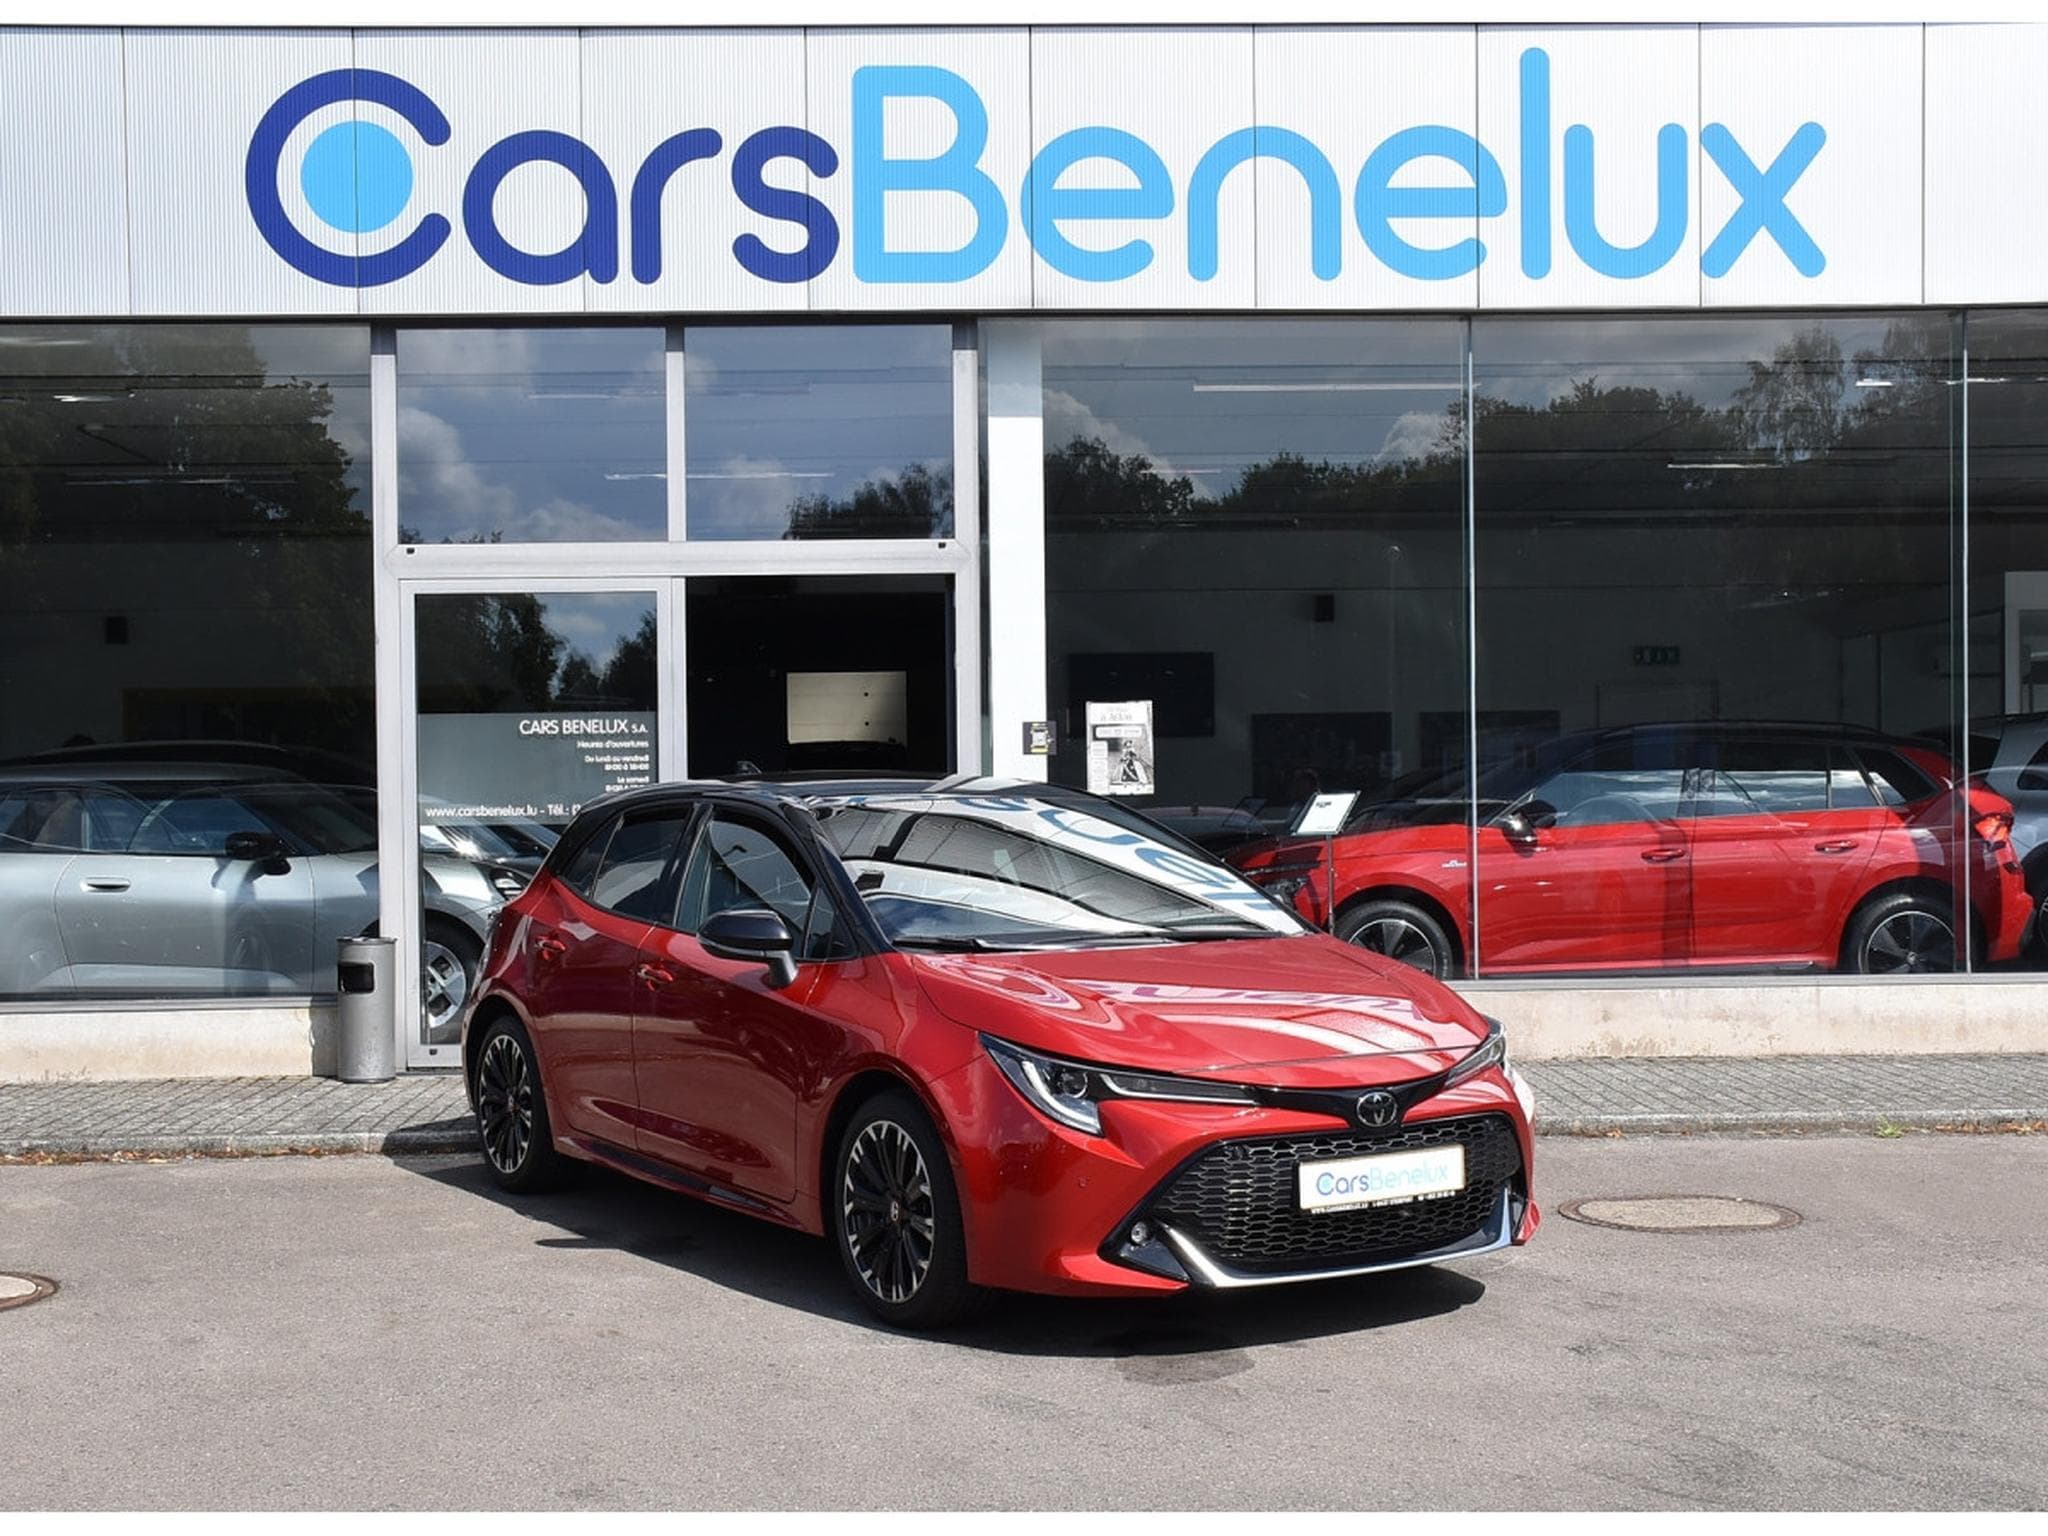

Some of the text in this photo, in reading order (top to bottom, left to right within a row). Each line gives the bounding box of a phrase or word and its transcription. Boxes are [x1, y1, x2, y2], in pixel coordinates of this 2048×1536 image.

[246, 48, 1827, 287] CarsBenelux
[519, 719, 559, 735] CARS
[562, 719, 629, 735] BENELUX
[425, 804, 538, 817] www.carsbenelux.lu
[1316, 1161, 1449, 1196] CarsBenelux
